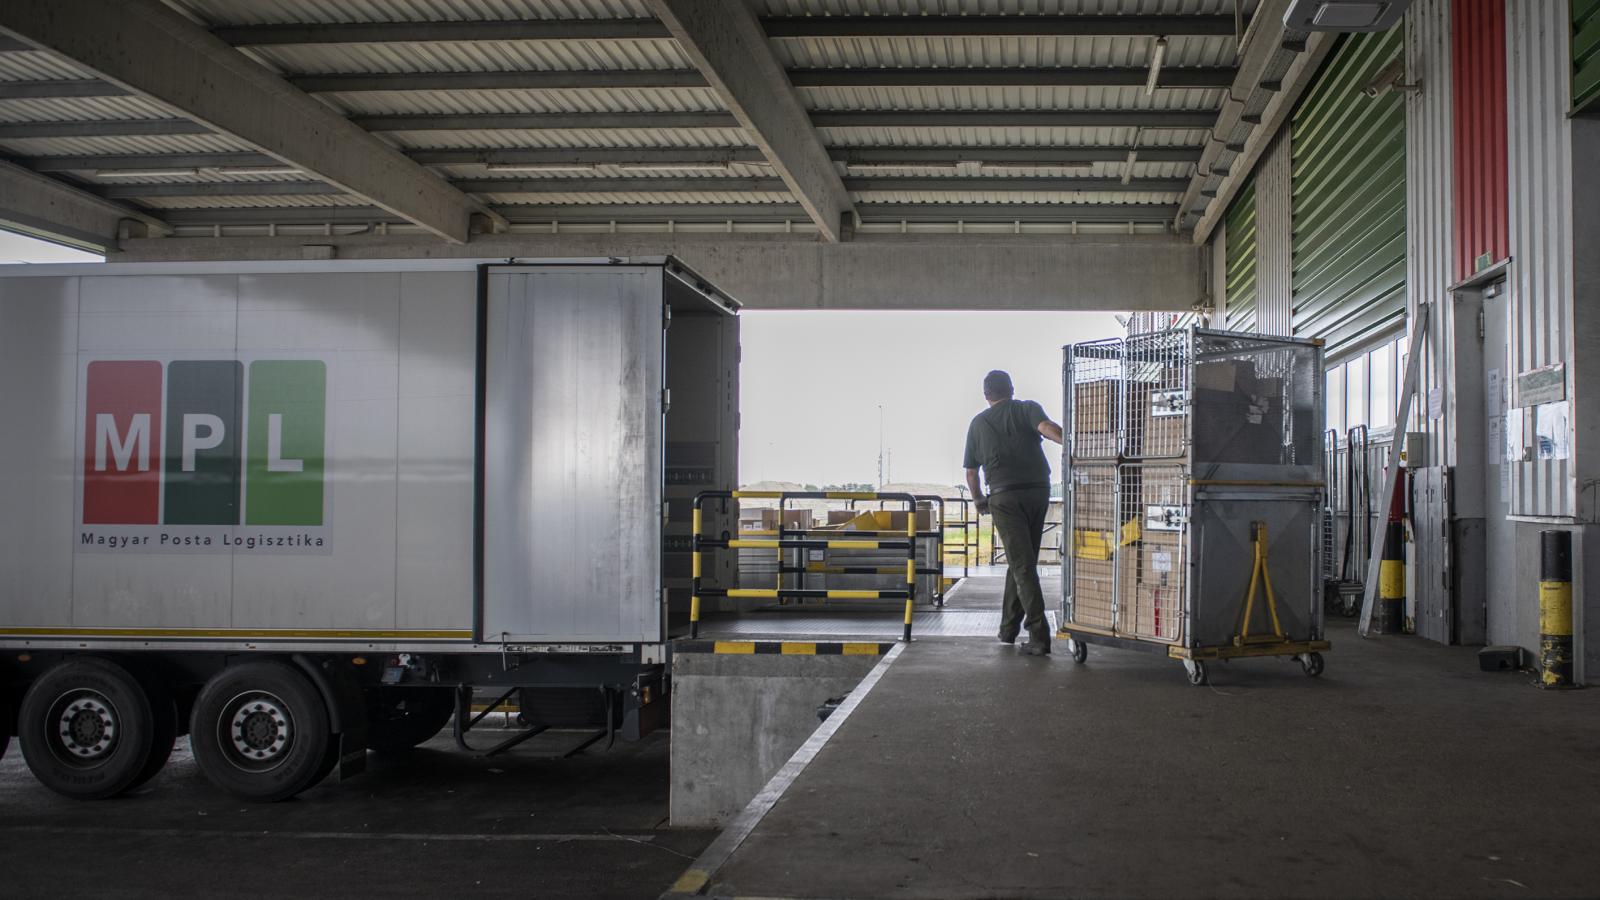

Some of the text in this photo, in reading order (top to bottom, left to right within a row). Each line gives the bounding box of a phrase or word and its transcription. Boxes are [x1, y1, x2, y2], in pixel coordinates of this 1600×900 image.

[95, 413, 303, 472] MPL
[81, 532, 323, 549] Magyar Posta Logisztika
